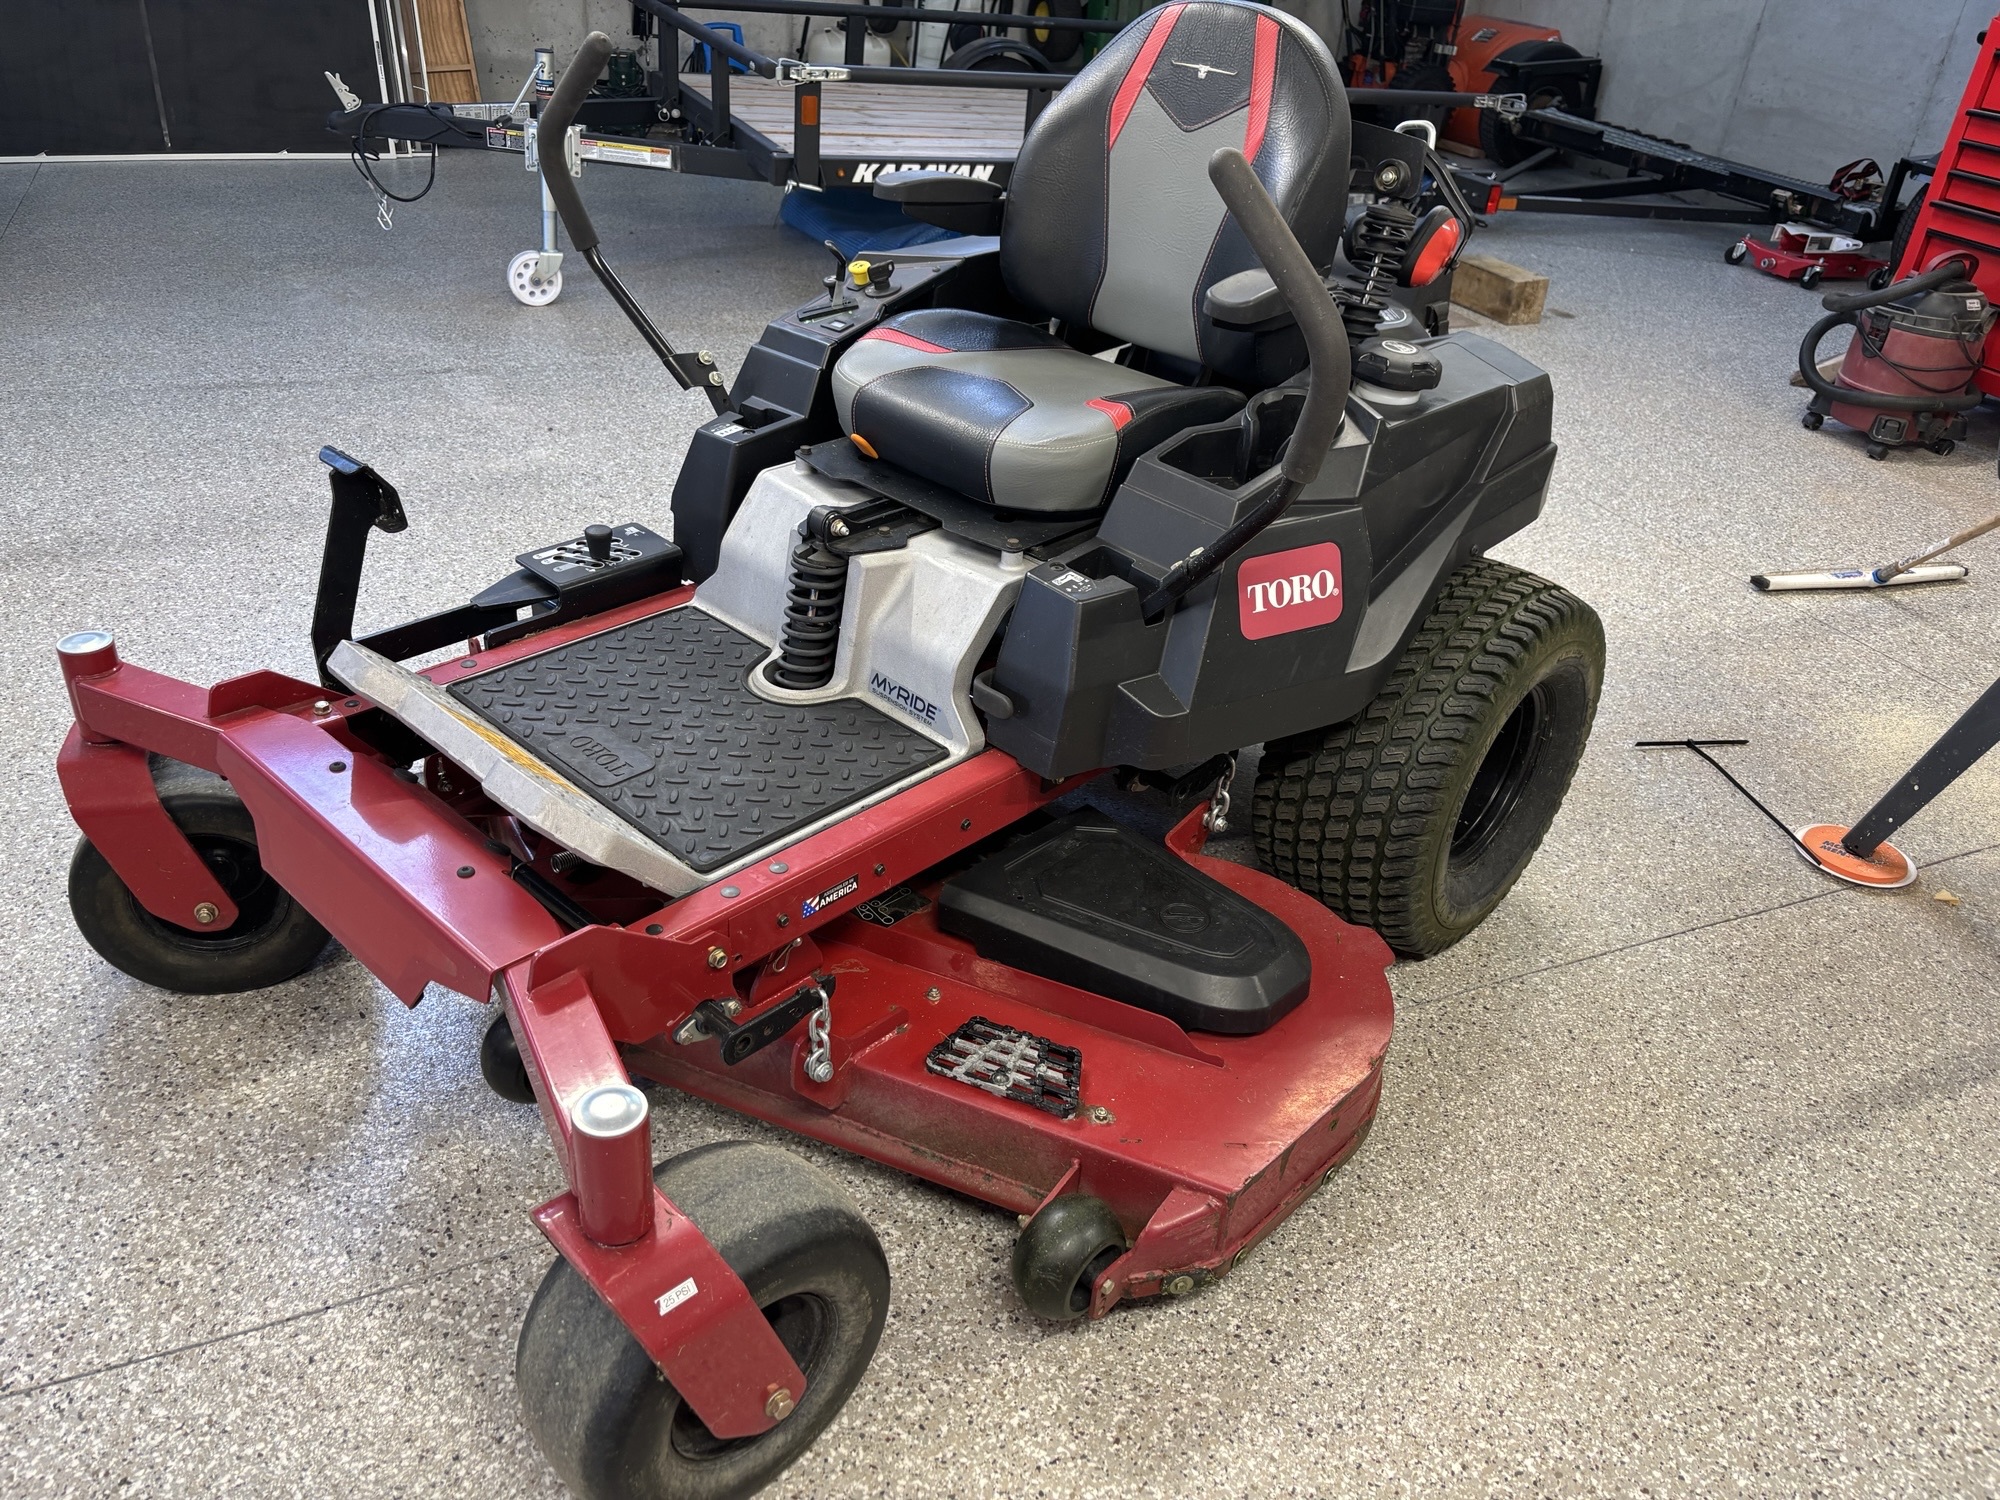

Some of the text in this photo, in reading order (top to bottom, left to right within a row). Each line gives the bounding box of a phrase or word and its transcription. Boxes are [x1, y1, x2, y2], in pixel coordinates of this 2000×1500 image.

[1247, 569, 1335, 613] TORO
[871, 672, 938, 721] MYRIDE
[872, 687, 933, 727] SUSPENSION SYSTEM
[570, 736, 634, 777] TORO
[820, 881, 858, 908] AMERICA
[663, 1284, 692, 1308] 25 PSI
